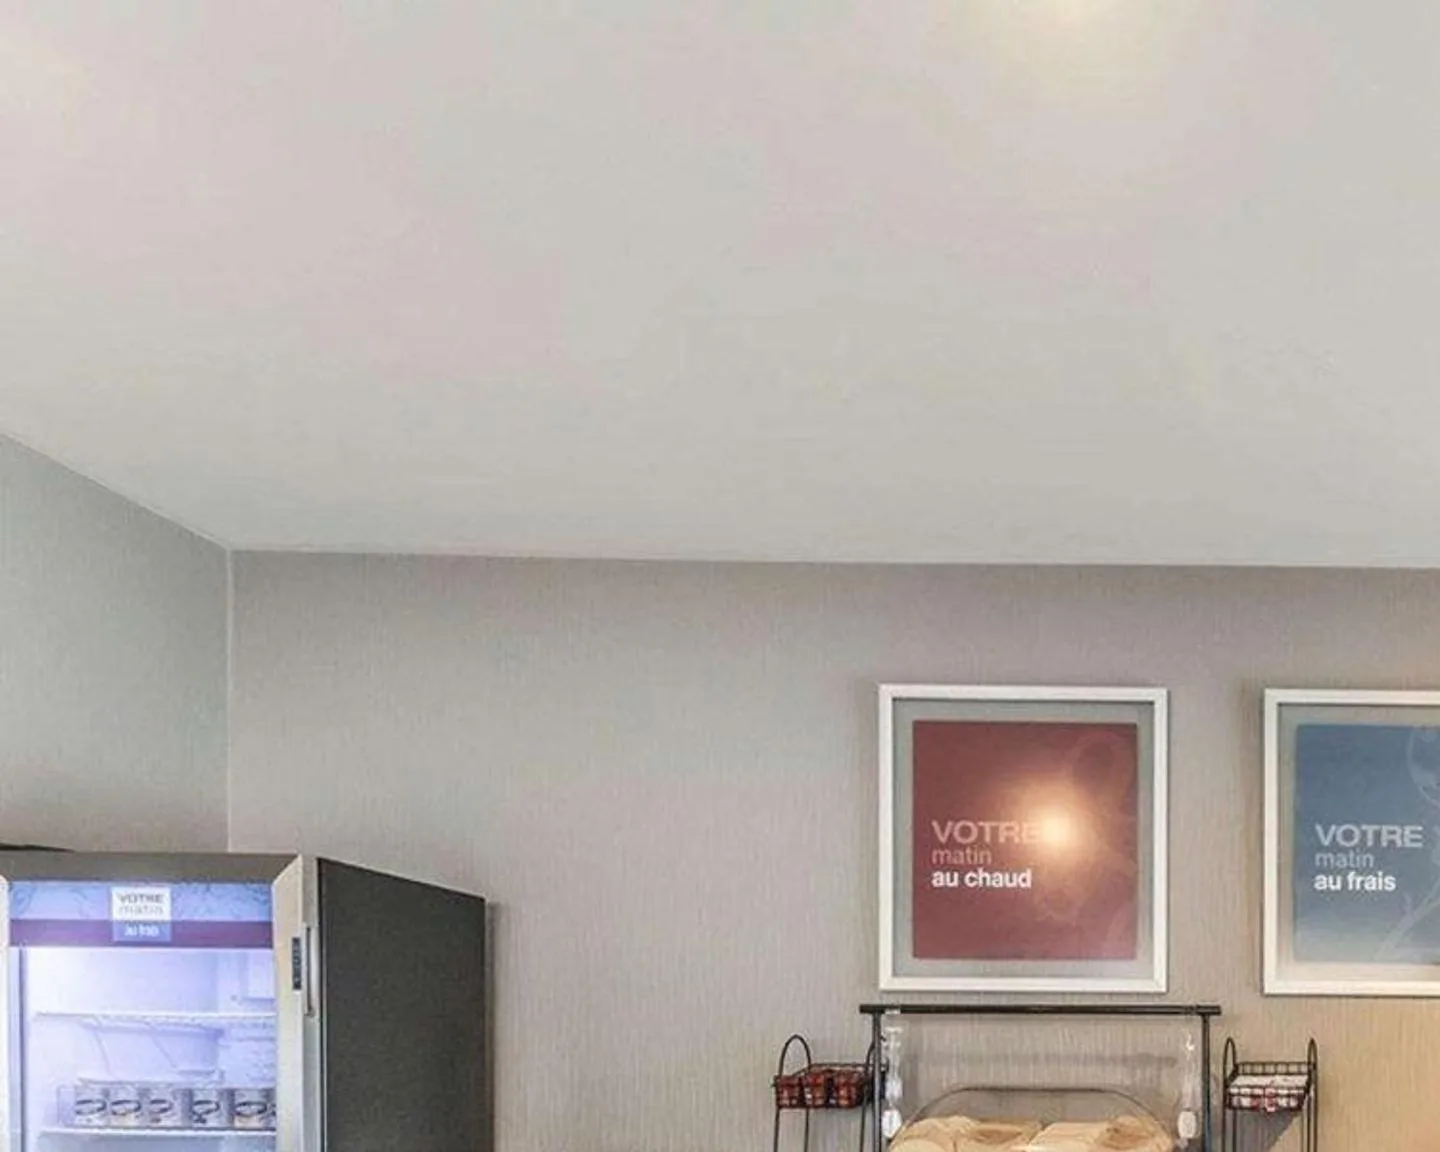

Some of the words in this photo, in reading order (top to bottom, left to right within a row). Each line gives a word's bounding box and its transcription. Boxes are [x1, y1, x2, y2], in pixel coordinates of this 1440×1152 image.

[931, 819, 1041, 844] VOTRE
[1315, 823, 1423, 848] VOTRE
[931, 846, 992, 865] matin
[1315, 848, 1374, 869] matin
[931, 870, 959, 888] au
[964, 867, 1032, 889] chaud
[1314, 873, 1342, 891] au
[1347, 870, 1397, 891] frais
